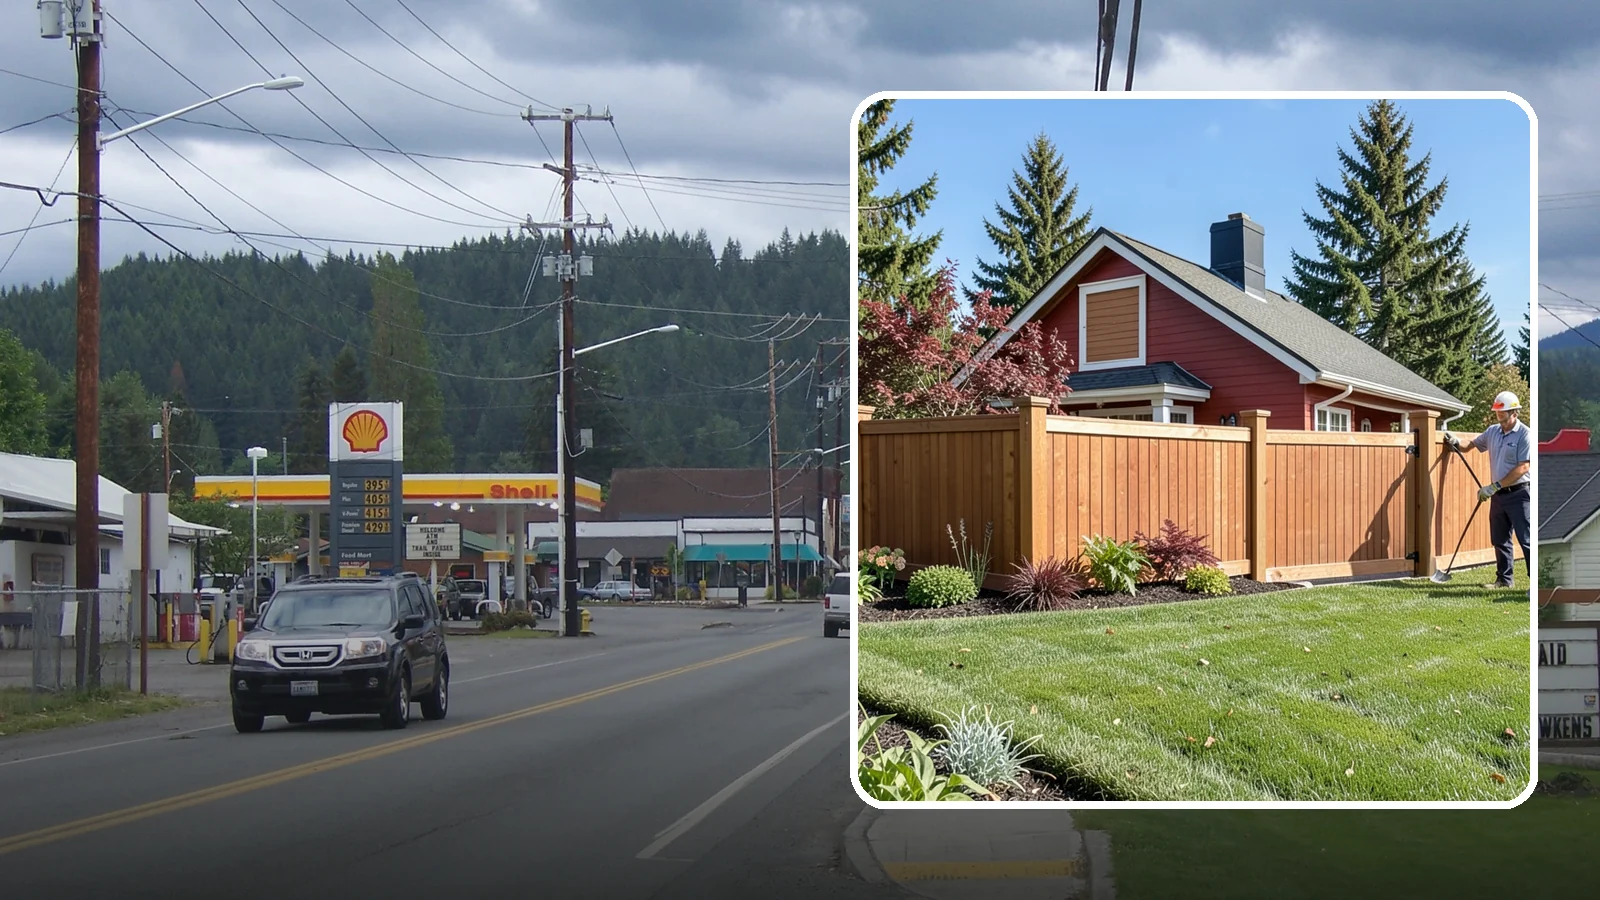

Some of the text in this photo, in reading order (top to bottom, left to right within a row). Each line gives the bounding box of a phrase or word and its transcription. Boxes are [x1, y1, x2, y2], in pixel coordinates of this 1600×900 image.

[365, 480, 384, 490] 395
[490, 484, 547, 499] Shell
[365, 494, 384, 504] 405
[365, 507, 384, 518] 415
[365, 522, 384, 532] 429
[1539, 643, 1566, 666] AID
